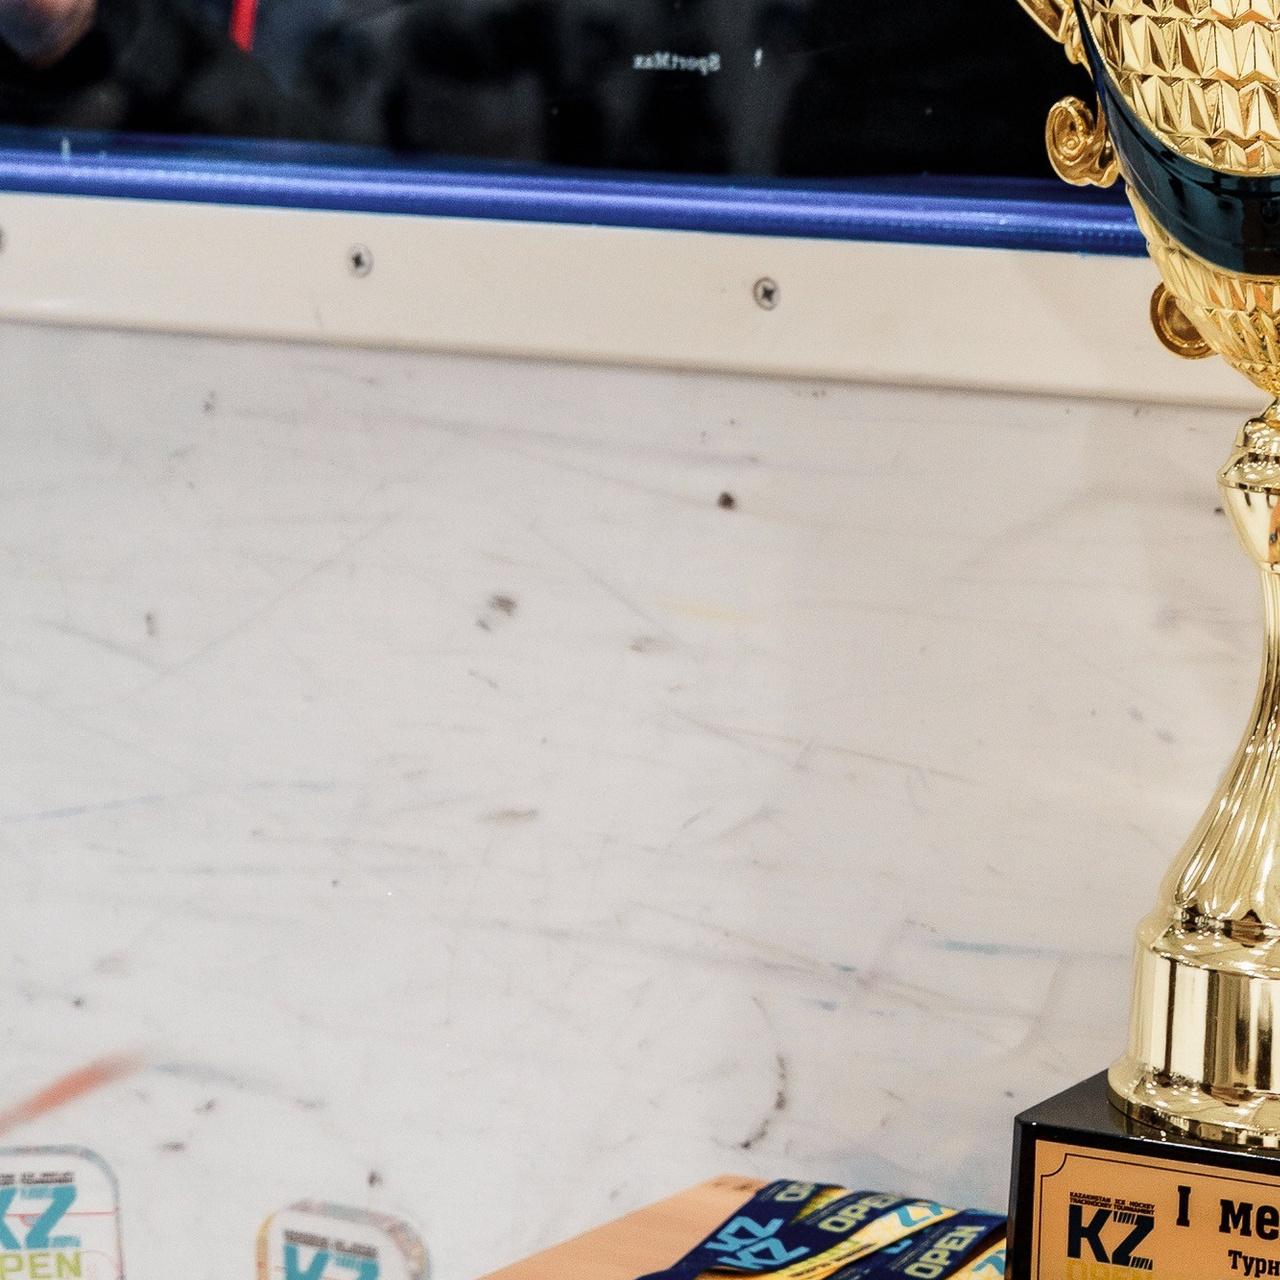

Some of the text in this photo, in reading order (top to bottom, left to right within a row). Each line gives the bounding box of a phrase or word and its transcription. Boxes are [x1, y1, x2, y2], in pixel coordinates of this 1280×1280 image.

[1176, 1185, 1191, 1227] I
[904, 1225, 989, 1280] OPEN
[1067, 1204, 1155, 1271] KZ
[0, 1251, 82, 1280] PEN
